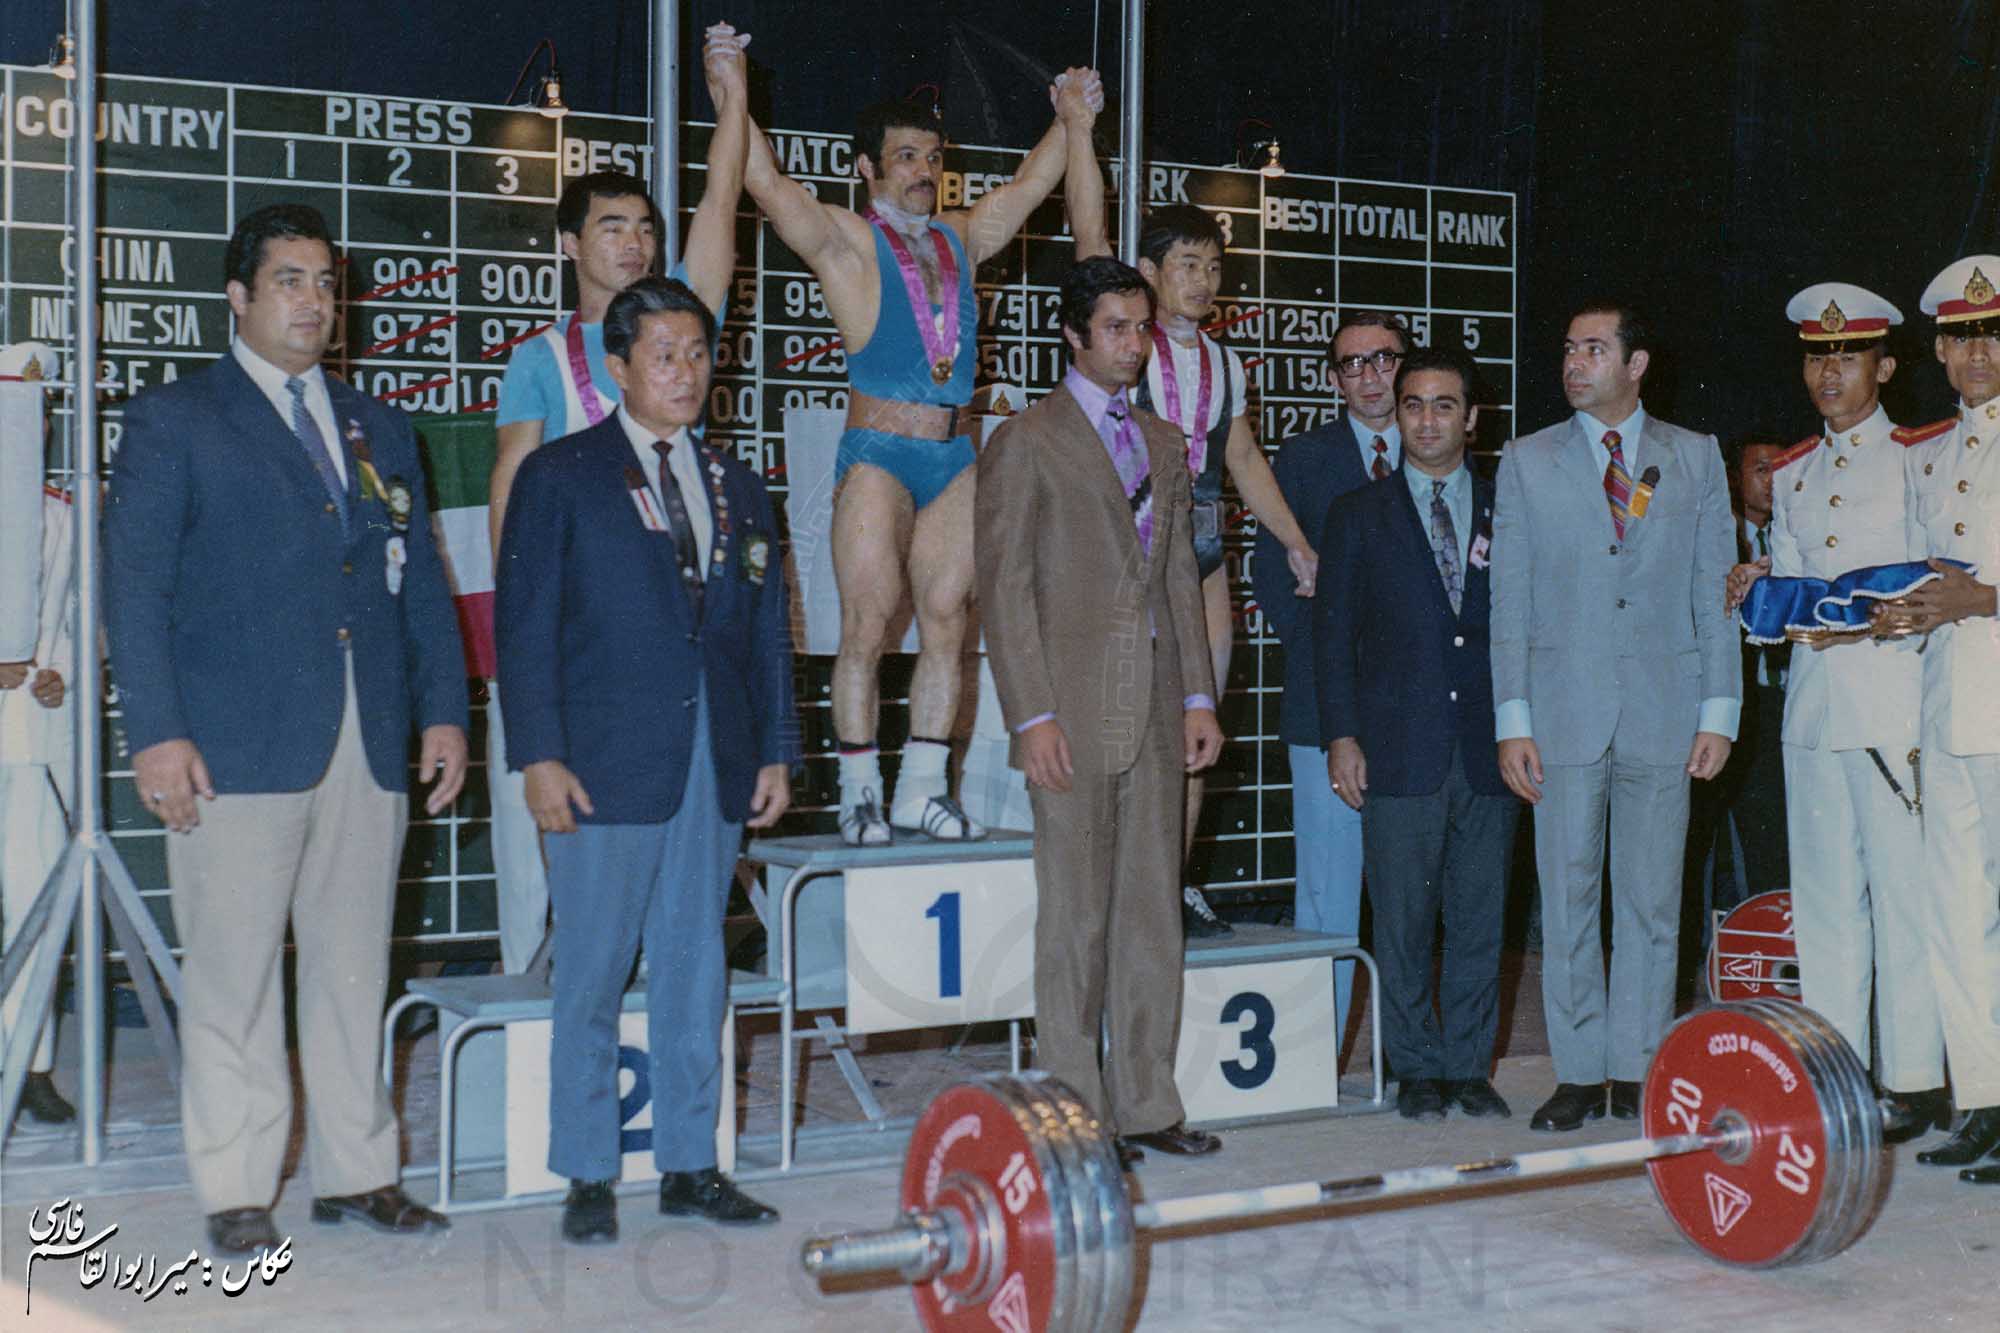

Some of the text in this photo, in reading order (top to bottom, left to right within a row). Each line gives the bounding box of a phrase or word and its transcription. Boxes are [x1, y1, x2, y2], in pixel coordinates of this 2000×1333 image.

[325, 96, 473, 145] PRESS
[284, 139, 297, 179] 1
[387, 147, 413, 187] 2
[495, 156, 520, 195] 3
[562, 137, 655, 182] BEST
[1264, 196, 1337, 235] BEST
[1340, 203, 1427, 242] TOTAL
[1437, 211, 1506, 248] RANK
[480, 263, 557, 305] 90.0
[31, 296, 202, 347] INDNESIA
[1266, 307, 1338, 344] 125.0
[1463, 317, 1481, 350] 5
[926, 891, 962, 999] 1
[1220, 992, 1276, 1090] 3
[1666, 1077, 1703, 1135] 20
[998, 1152, 1037, 1215] 15
[1775, 1133, 1816, 1195] 20
